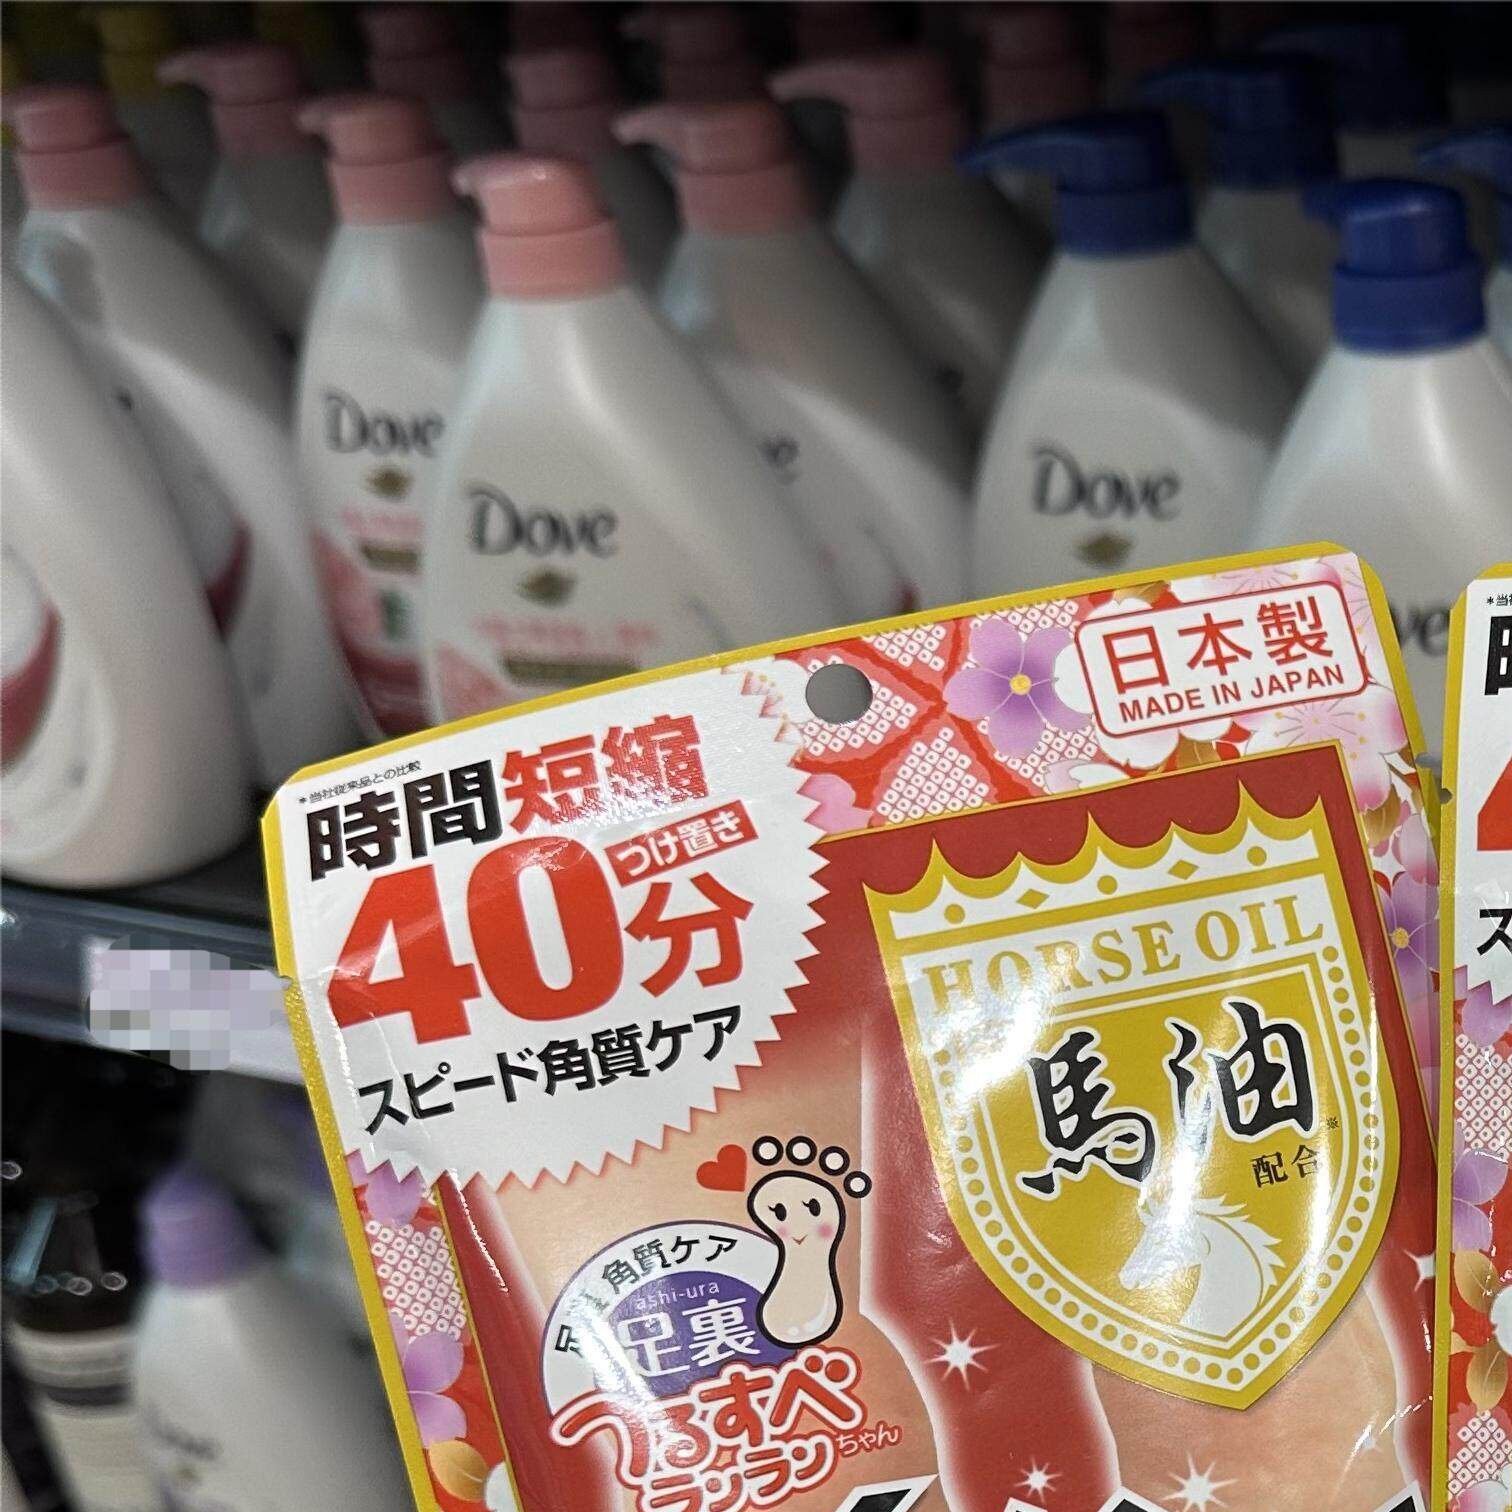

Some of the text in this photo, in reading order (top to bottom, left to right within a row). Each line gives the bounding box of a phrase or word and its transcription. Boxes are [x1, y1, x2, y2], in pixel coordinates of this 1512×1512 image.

[321, 388, 446, 458] Dove
[464, 481, 620, 559] Dove
[1031, 442, 1183, 522] Dove
[1101, 595, 1336, 696] 日本製
[1118, 663, 1346, 725] MADE IN JAPAN
[306, 713, 710, 882] 時間短縮
[616, 808, 745, 877] つけ置き
[326, 835, 756, 1046] 40分
[920, 893, 1326, 1014] HORSE OIL
[357, 1004, 744, 1137] スピード角質ケア
[1021, 1000, 1317, 1196] 馬油
[1250, 1143, 1324, 1189] 配合
[601, 1234, 738, 1295] 角質ケア
[634, 1280, 721, 1313] ashi-ura
[616, 1297, 761, 1378] 足裏
